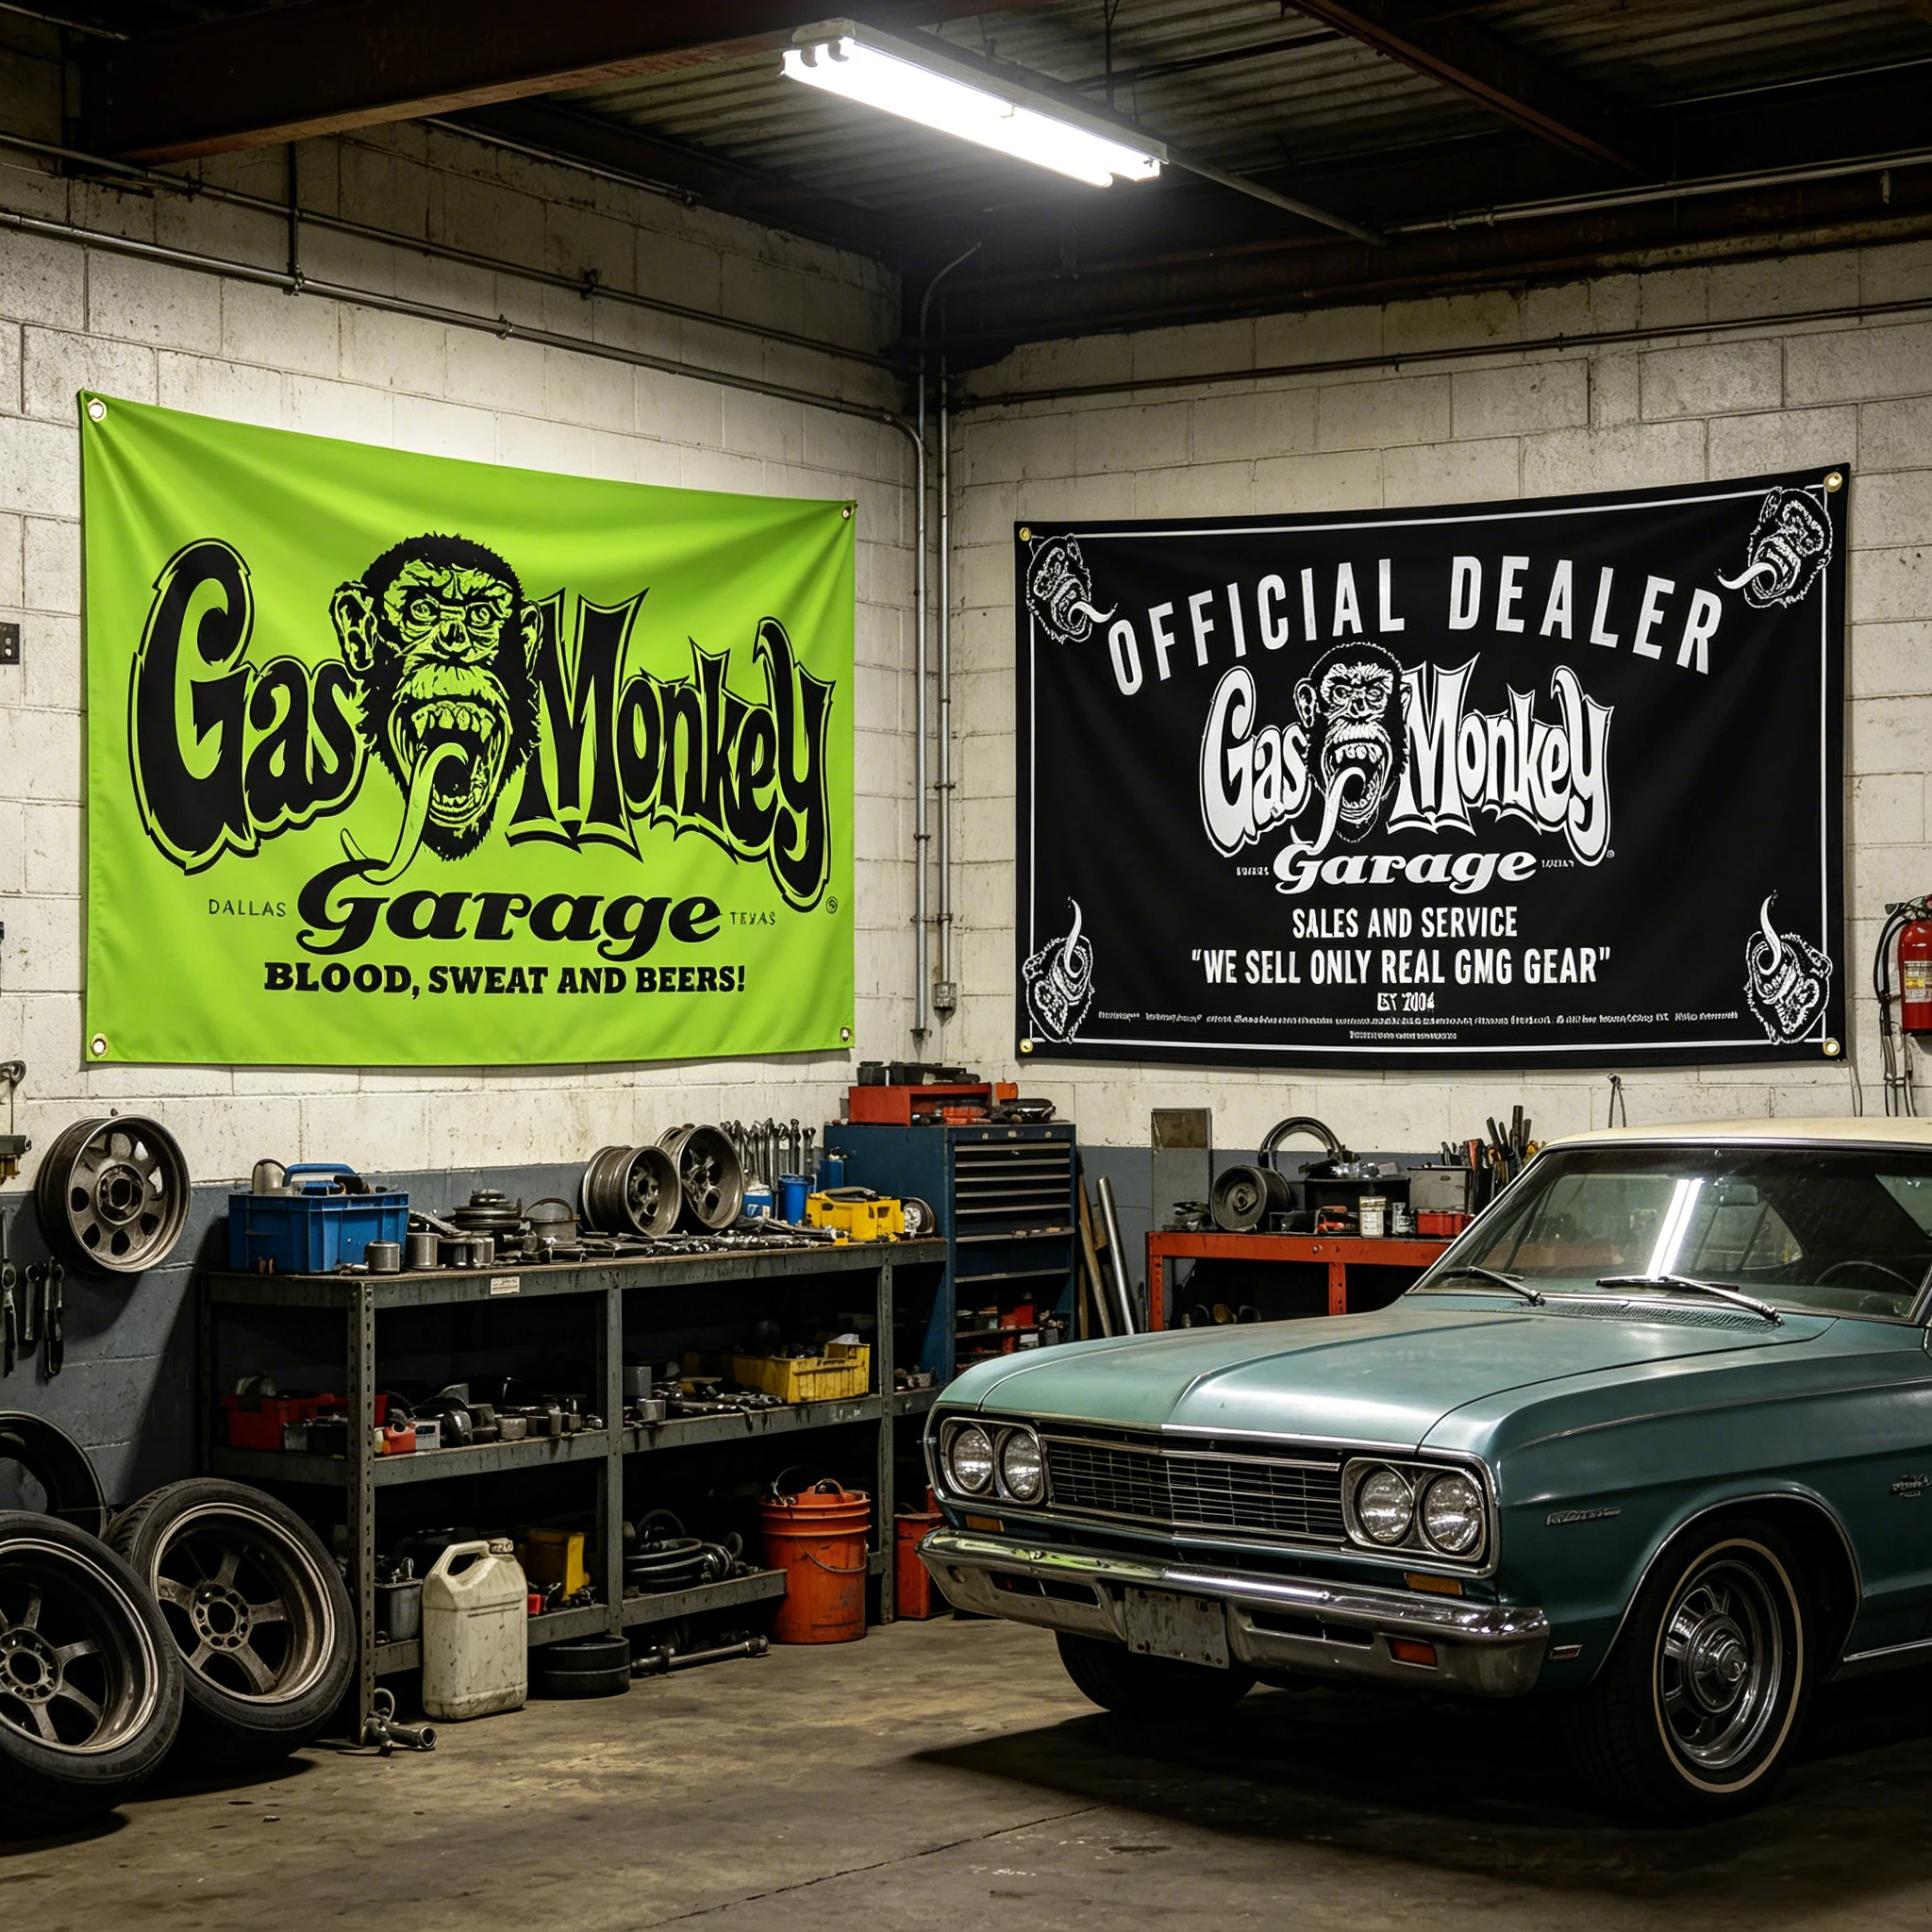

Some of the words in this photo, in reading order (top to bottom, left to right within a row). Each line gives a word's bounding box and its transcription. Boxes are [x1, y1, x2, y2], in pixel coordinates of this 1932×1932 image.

[1108, 558, 1405, 696] OFFICIAL
[1448, 556, 1722, 675] DEALER
[128, 538, 367, 875] Gas
[506, 586, 835, 913] Monkey
[1200, 666, 1311, 858] Gas
[1388, 652, 1614, 867] Monkey
[1274, 843, 1537, 894] Garage
[208, 899, 287, 918] DALLAS
[295, 859, 722, 962] Garage
[730, 911, 775, 925] TEXAS
[1292, 908, 1358, 939] SALES
[1367, 908, 1412, 939] AND
[1421, 906, 1518, 937] SERVICE
[264, 962, 420, 1000] BLOOD,
[428, 965, 548, 994] SWEAT
[557, 966, 626, 994] AND
[635, 965, 745, 993] BEERS!
[1244, 949, 1301, 984] SELL
[1310, 949, 1372, 984] ONLY
[1381, 949, 1445, 984] REAL
[1455, 948, 1512, 985] GMG
